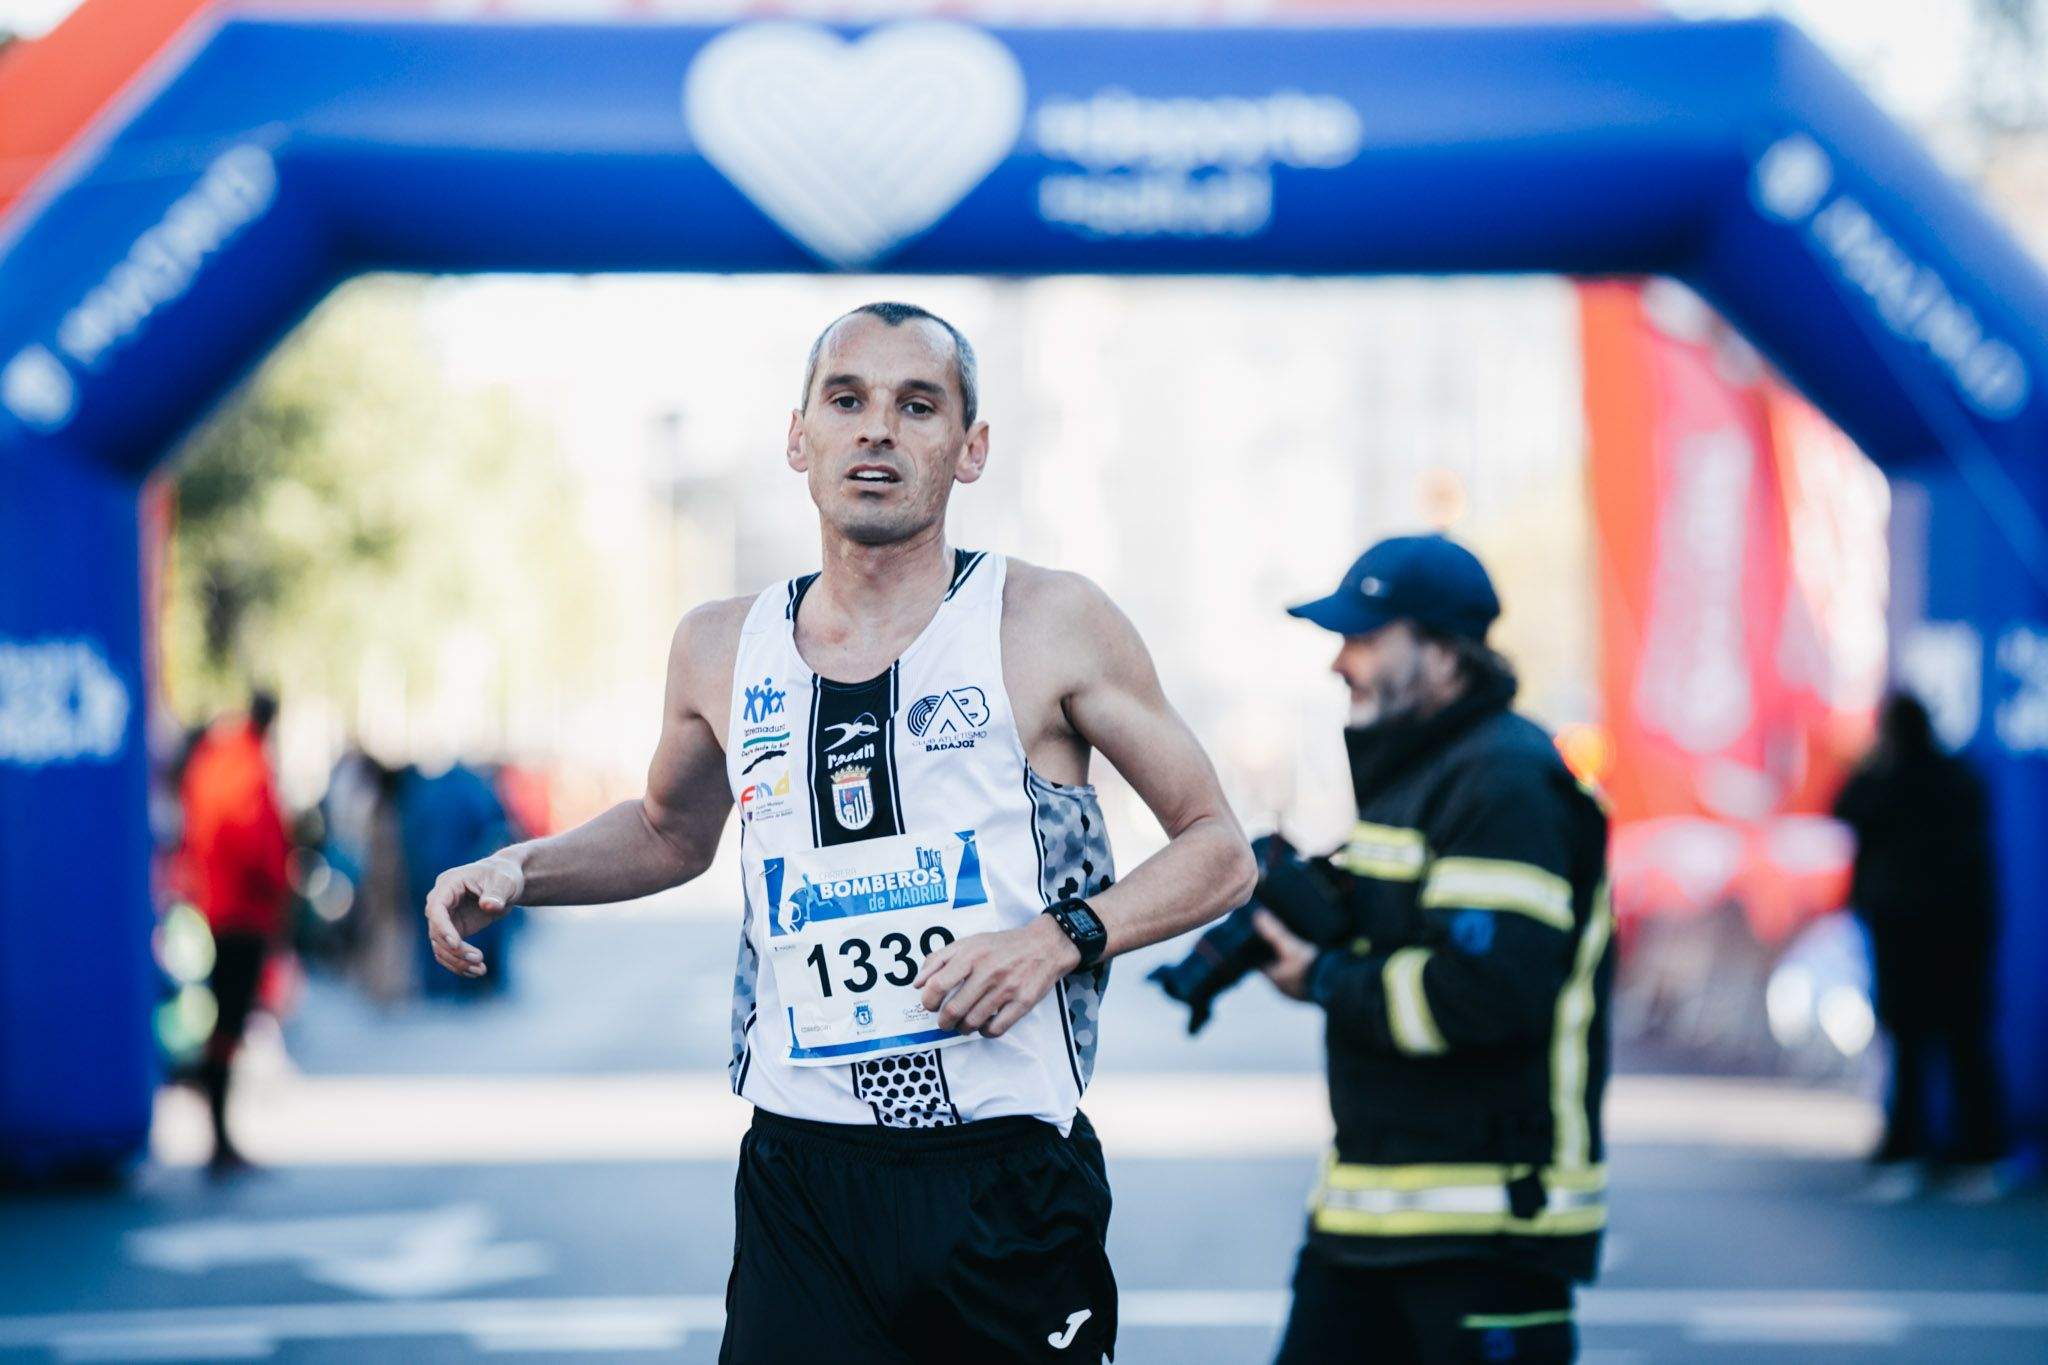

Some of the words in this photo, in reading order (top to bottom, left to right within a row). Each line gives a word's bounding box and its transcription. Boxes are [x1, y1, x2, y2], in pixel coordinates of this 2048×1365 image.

[926, 739, 975, 752] BADAJOZ
[820, 866, 943, 900] BOMBEROS
[868, 894, 886, 912] de
[890, 883, 945, 909] MADRID
